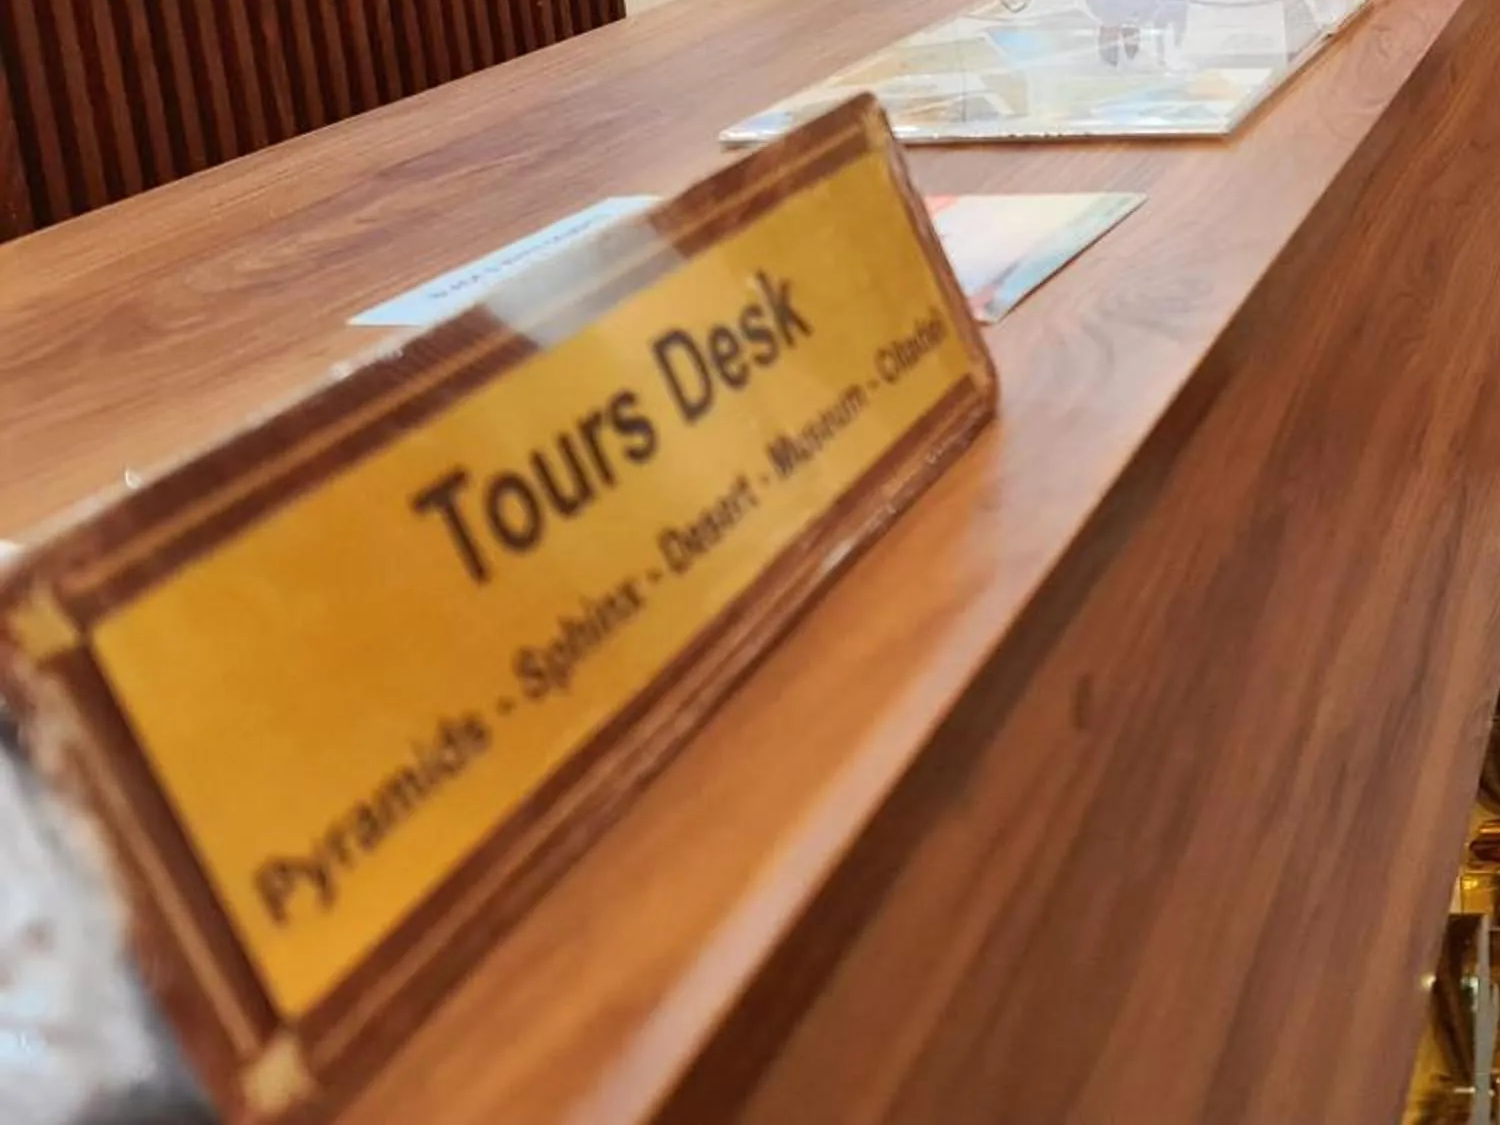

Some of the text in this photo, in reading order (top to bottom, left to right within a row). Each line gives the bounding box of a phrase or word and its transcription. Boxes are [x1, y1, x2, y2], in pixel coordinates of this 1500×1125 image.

[411, 267, 815, 587] Tours Desk
[253, 710, 493, 931] Pyramids
[512, 577, 646, 702] Sphinx
[657, 474, 760, 575] Desert
[765, 383, 867, 481] Museum
